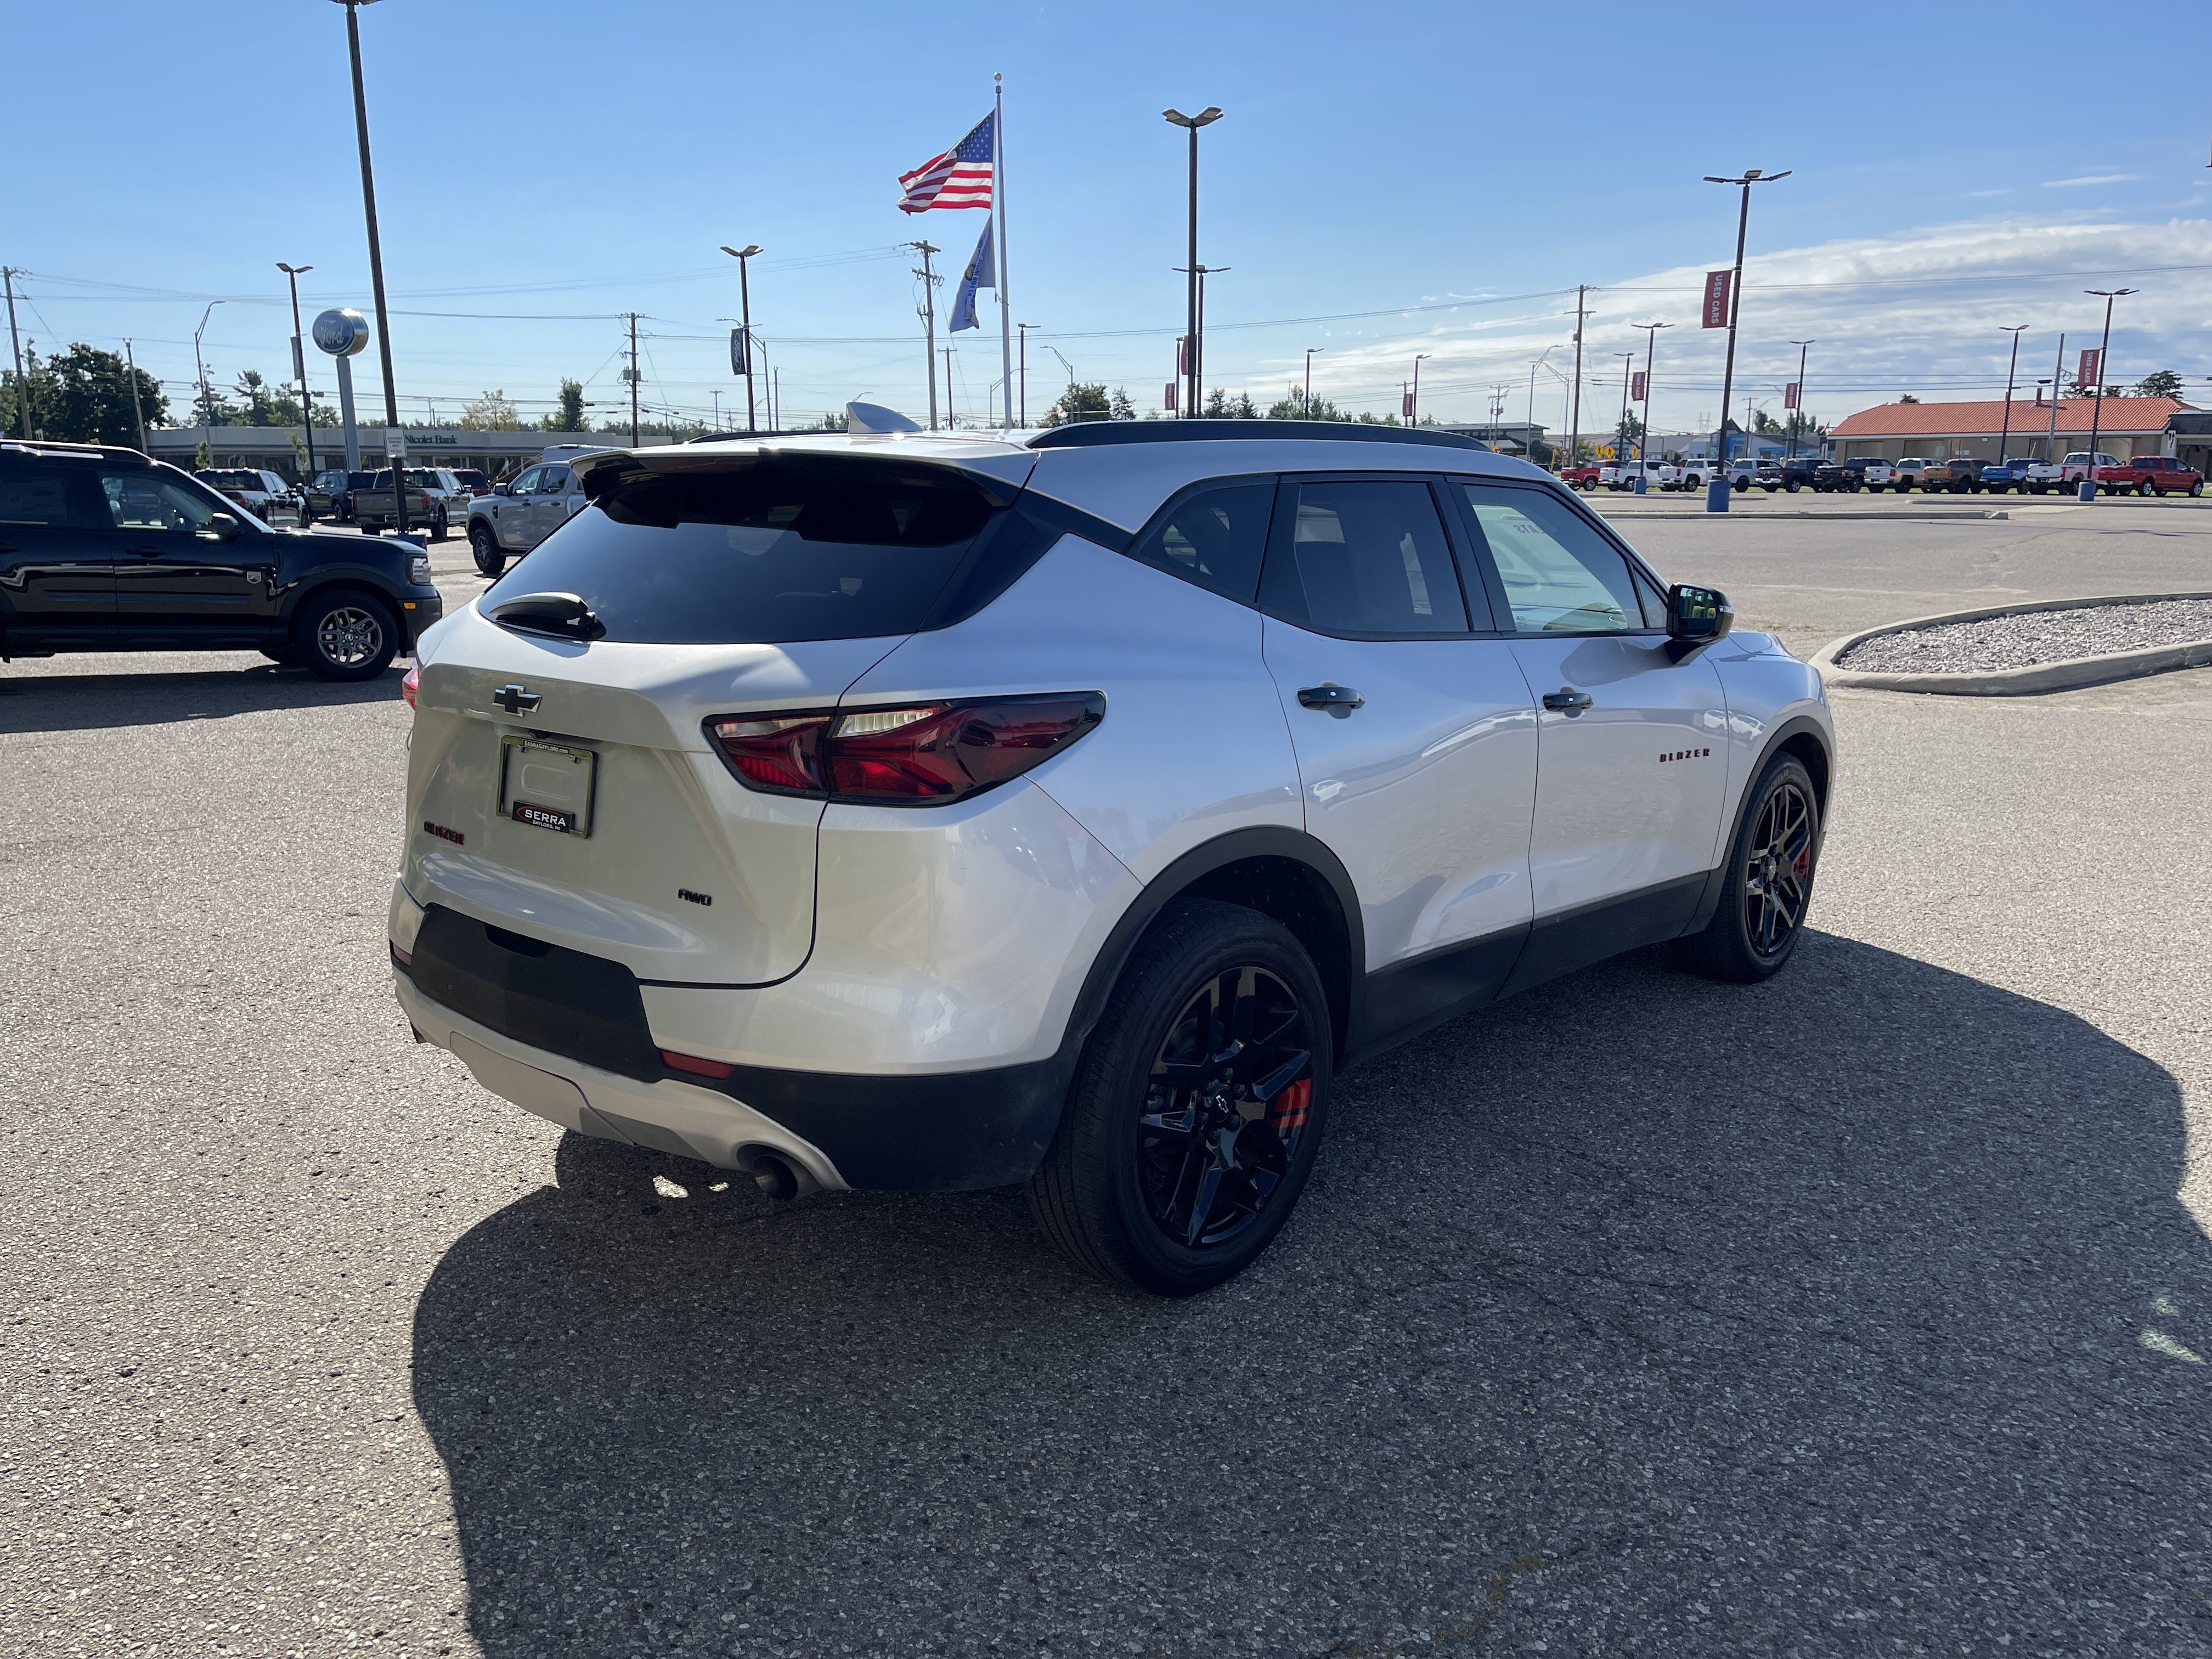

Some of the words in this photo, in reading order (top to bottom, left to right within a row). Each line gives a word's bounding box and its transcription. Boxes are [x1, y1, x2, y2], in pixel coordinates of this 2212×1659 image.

[1713, 275, 1723, 298] USED
[1711, 300, 1720, 324] CARS
[320, 319, 345, 346] Ford
[405, 435, 433, 444] Nicolet
[435, 435, 458, 444] Bank
[1660, 748, 1710, 763] BLAZER
[524, 809, 566, 827] SERRA
[678, 888, 712, 906] AWD
